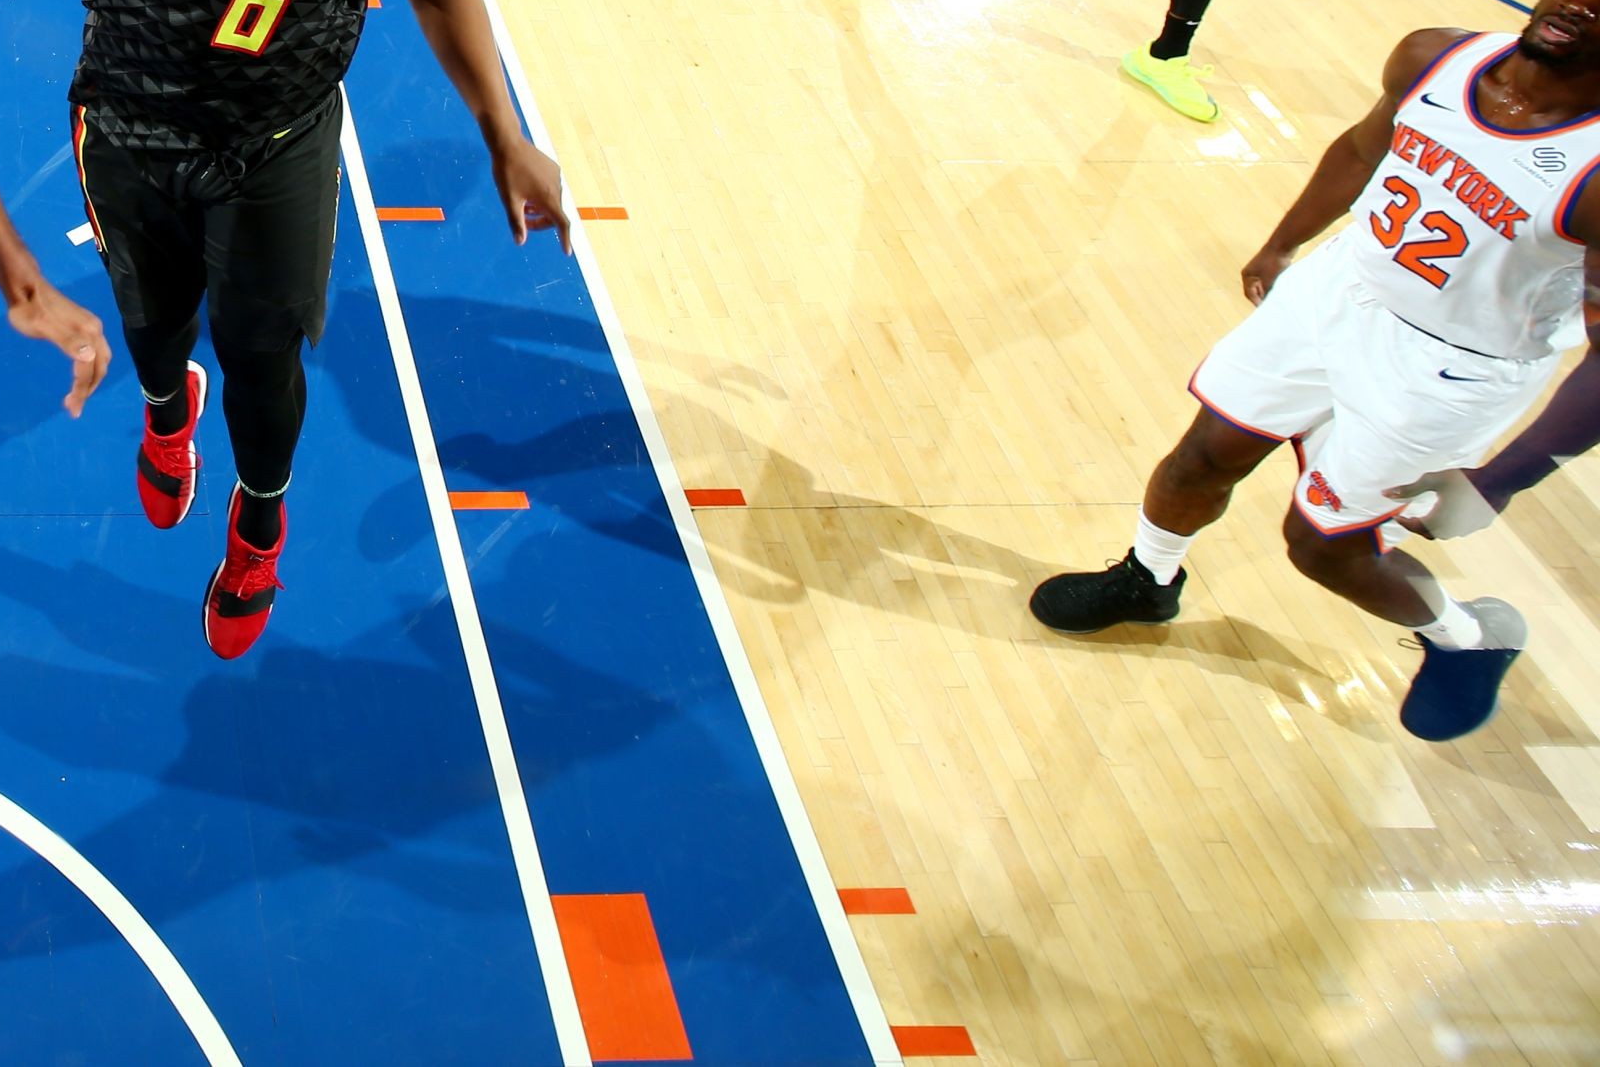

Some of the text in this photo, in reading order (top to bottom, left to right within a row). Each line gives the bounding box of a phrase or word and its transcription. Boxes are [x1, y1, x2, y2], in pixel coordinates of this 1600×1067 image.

[1370, 176, 1470, 290] 32
[1391, 122, 1531, 241] NEW YORK
